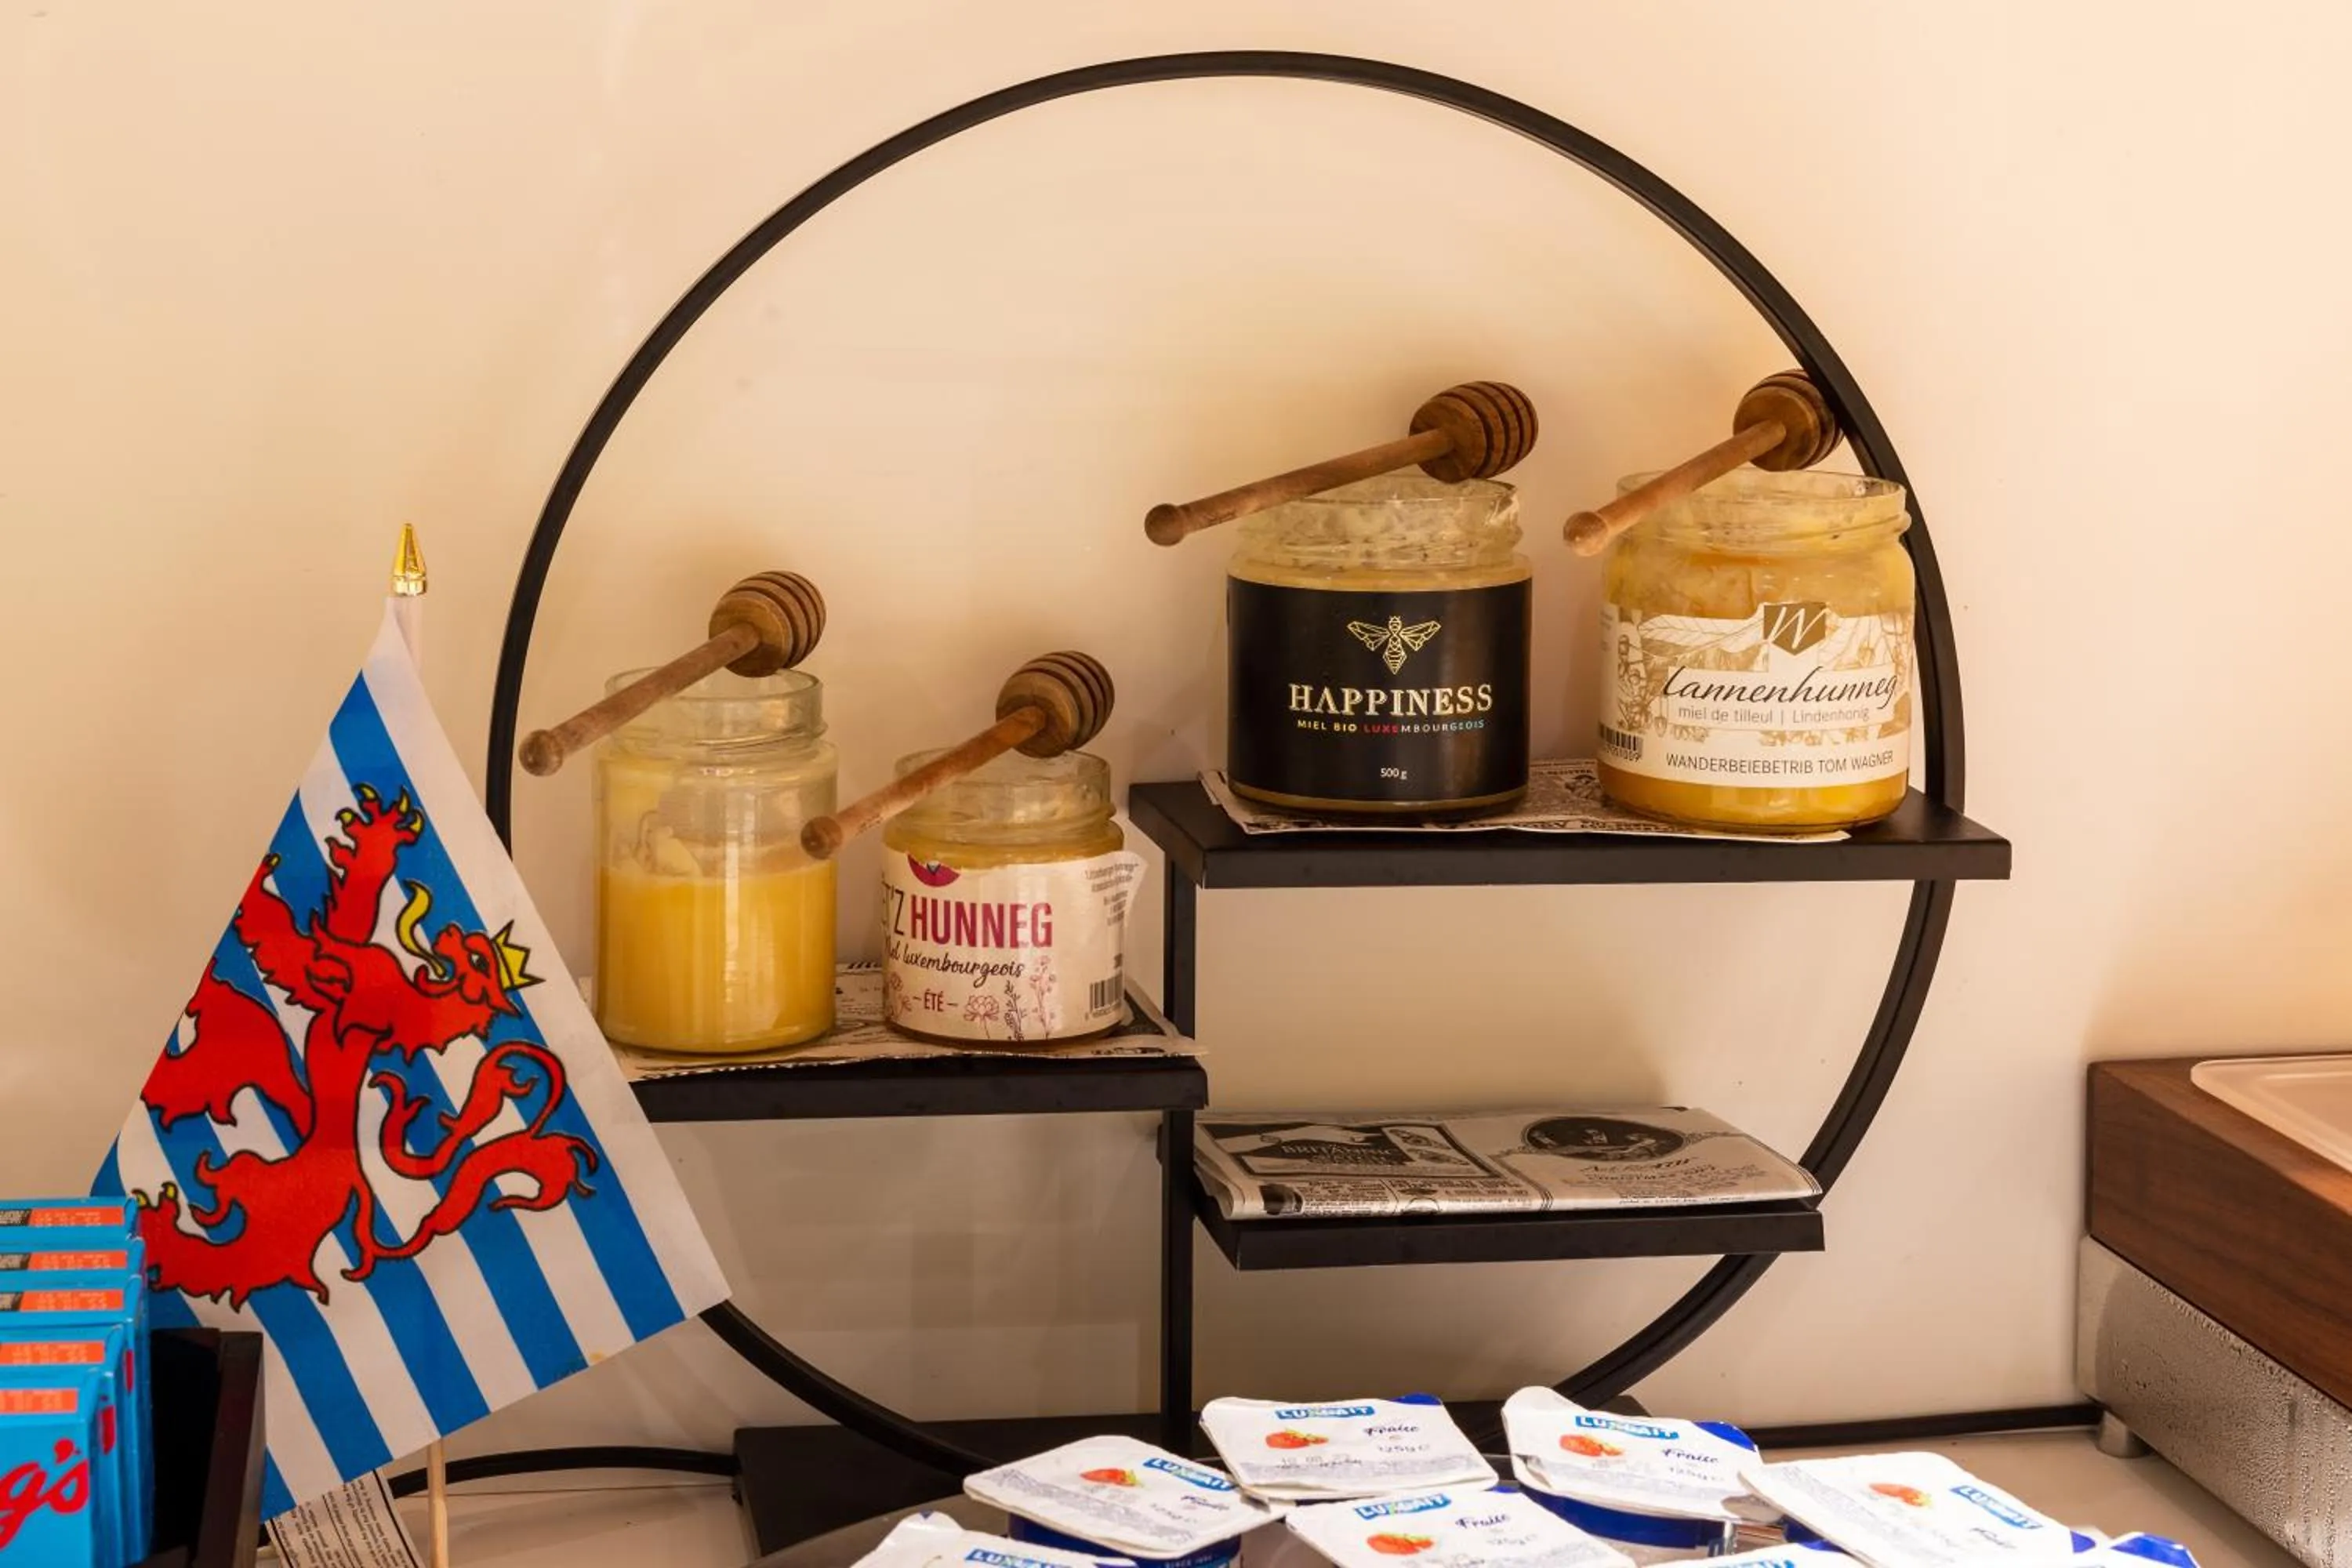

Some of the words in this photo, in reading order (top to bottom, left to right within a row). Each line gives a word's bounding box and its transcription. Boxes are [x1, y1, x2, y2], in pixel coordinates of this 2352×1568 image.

[1288, 683, 1493, 716] HAPPINESS
[1298, 719, 1327, 730] MIEL
[1334, 723, 1357, 732] BIO
[1363, 719, 1484, 734] LUXEMBOURGEOIS
[1679, 706, 1707, 720] miel
[1711, 709, 1729, 721] de
[1733, 708, 1773, 724] tilleul
[1792, 708, 1871, 724] Lindenhonig
[1666, 753, 1813, 775] WANDERBEIEBETRIB
[1817, 758, 1846, 774] TOM
[1850, 750, 1893, 771] WAGNER
[910, 895, 1053, 949] HUNNEG
[902, 944, 1025, 988] luxembourgeois
[924, 989, 944, 1012] ÉTÉ
